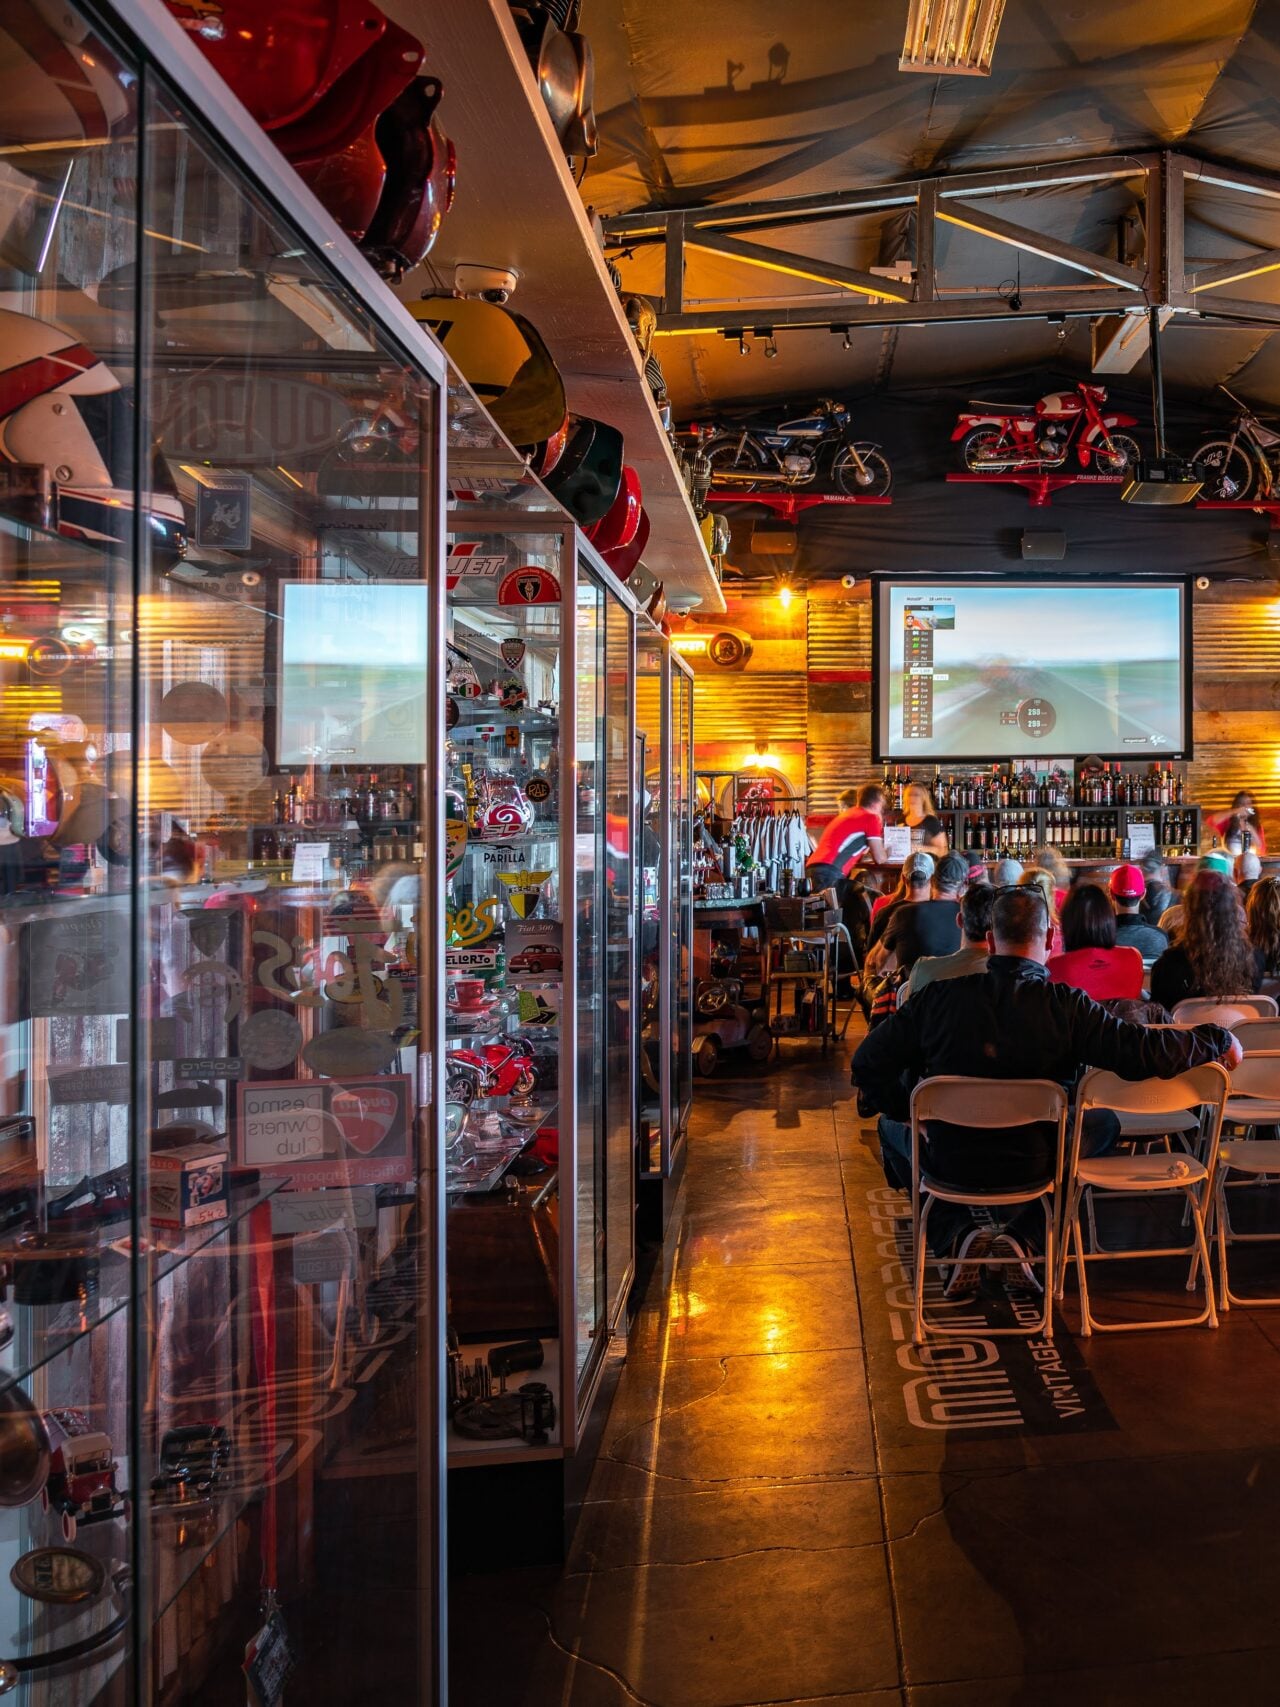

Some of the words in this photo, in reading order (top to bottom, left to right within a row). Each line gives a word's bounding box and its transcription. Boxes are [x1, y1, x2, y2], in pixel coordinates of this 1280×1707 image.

[823, 494, 845, 502] YAMAHA
[482, 823, 526, 836] SIDI
[483, 852, 526, 863] PARILLA
[446, 954, 491, 965] ELLORTO
[1027, 1338, 1087, 1419] VINTAGE
